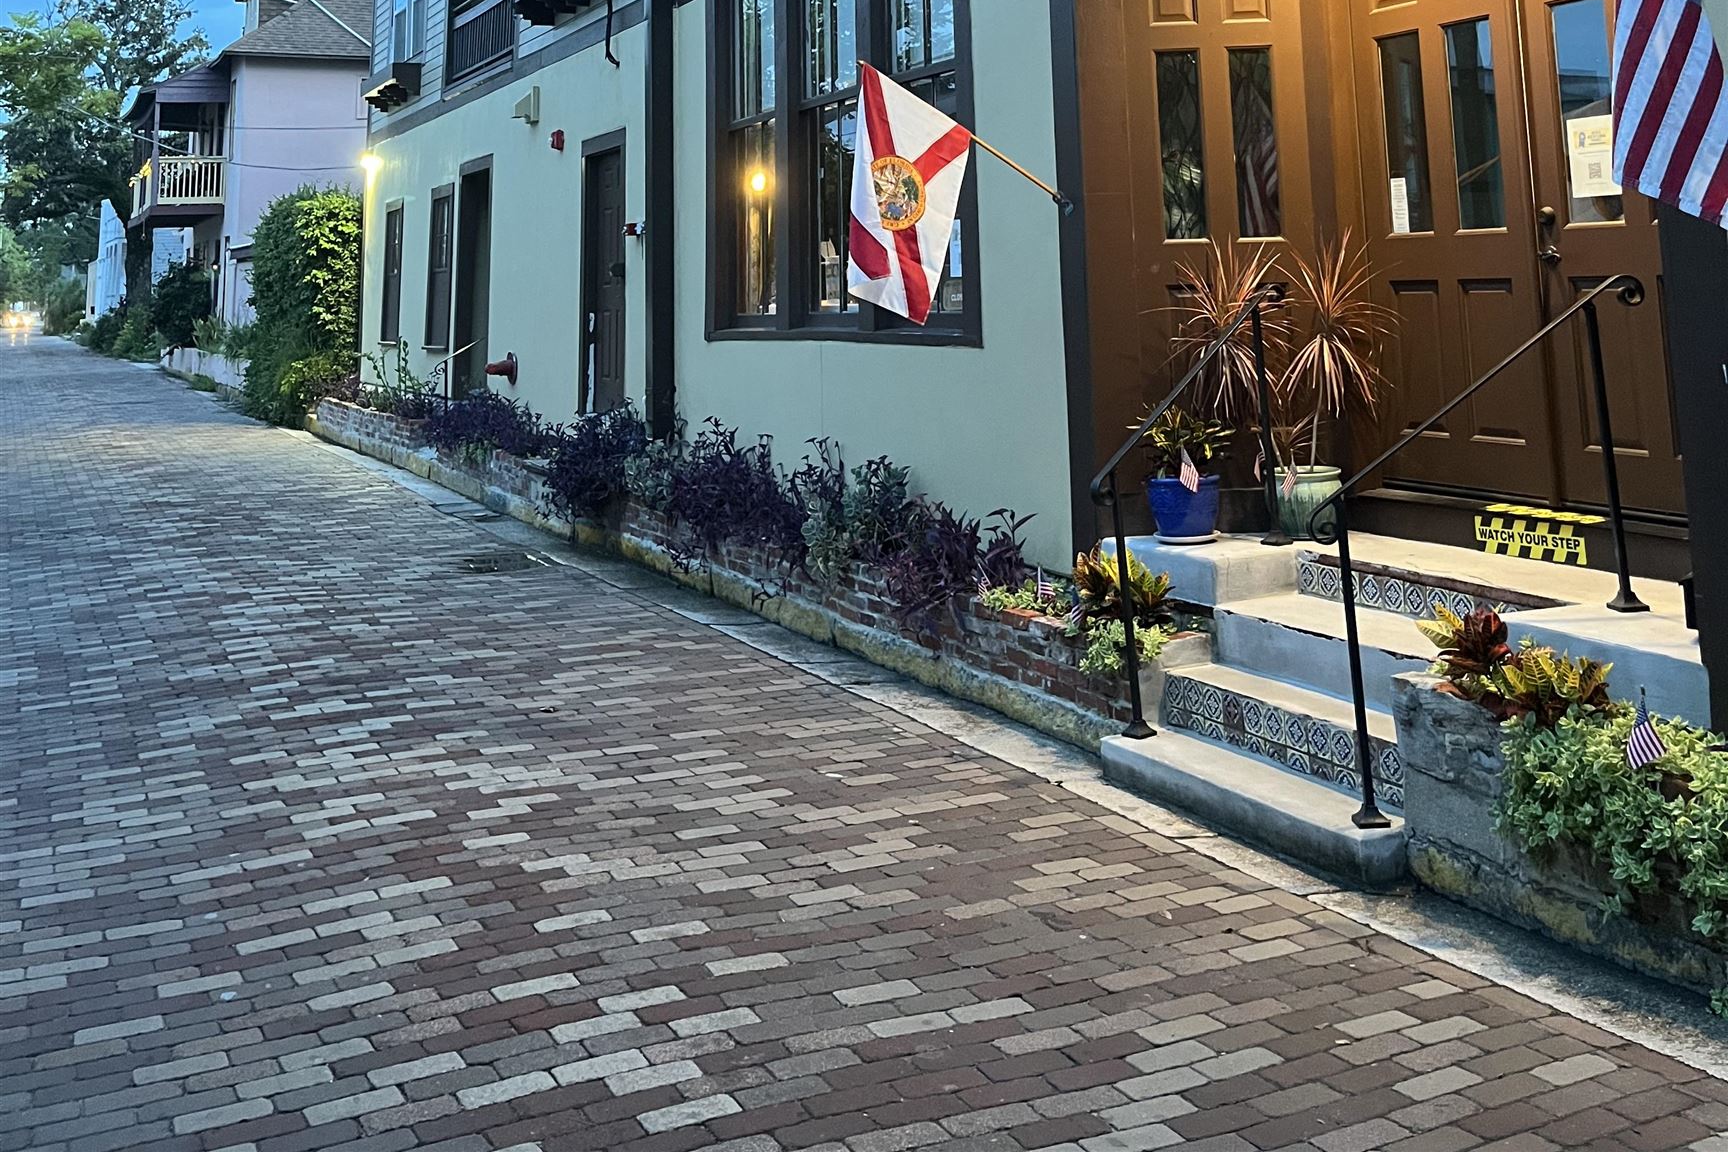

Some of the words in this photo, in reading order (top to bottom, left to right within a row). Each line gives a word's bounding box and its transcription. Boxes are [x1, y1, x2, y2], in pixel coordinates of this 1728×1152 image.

[1478, 527, 1515, 543] WATCH
[1518, 532, 1549, 547] YOUR
[1551, 536, 1581, 551] STEP
